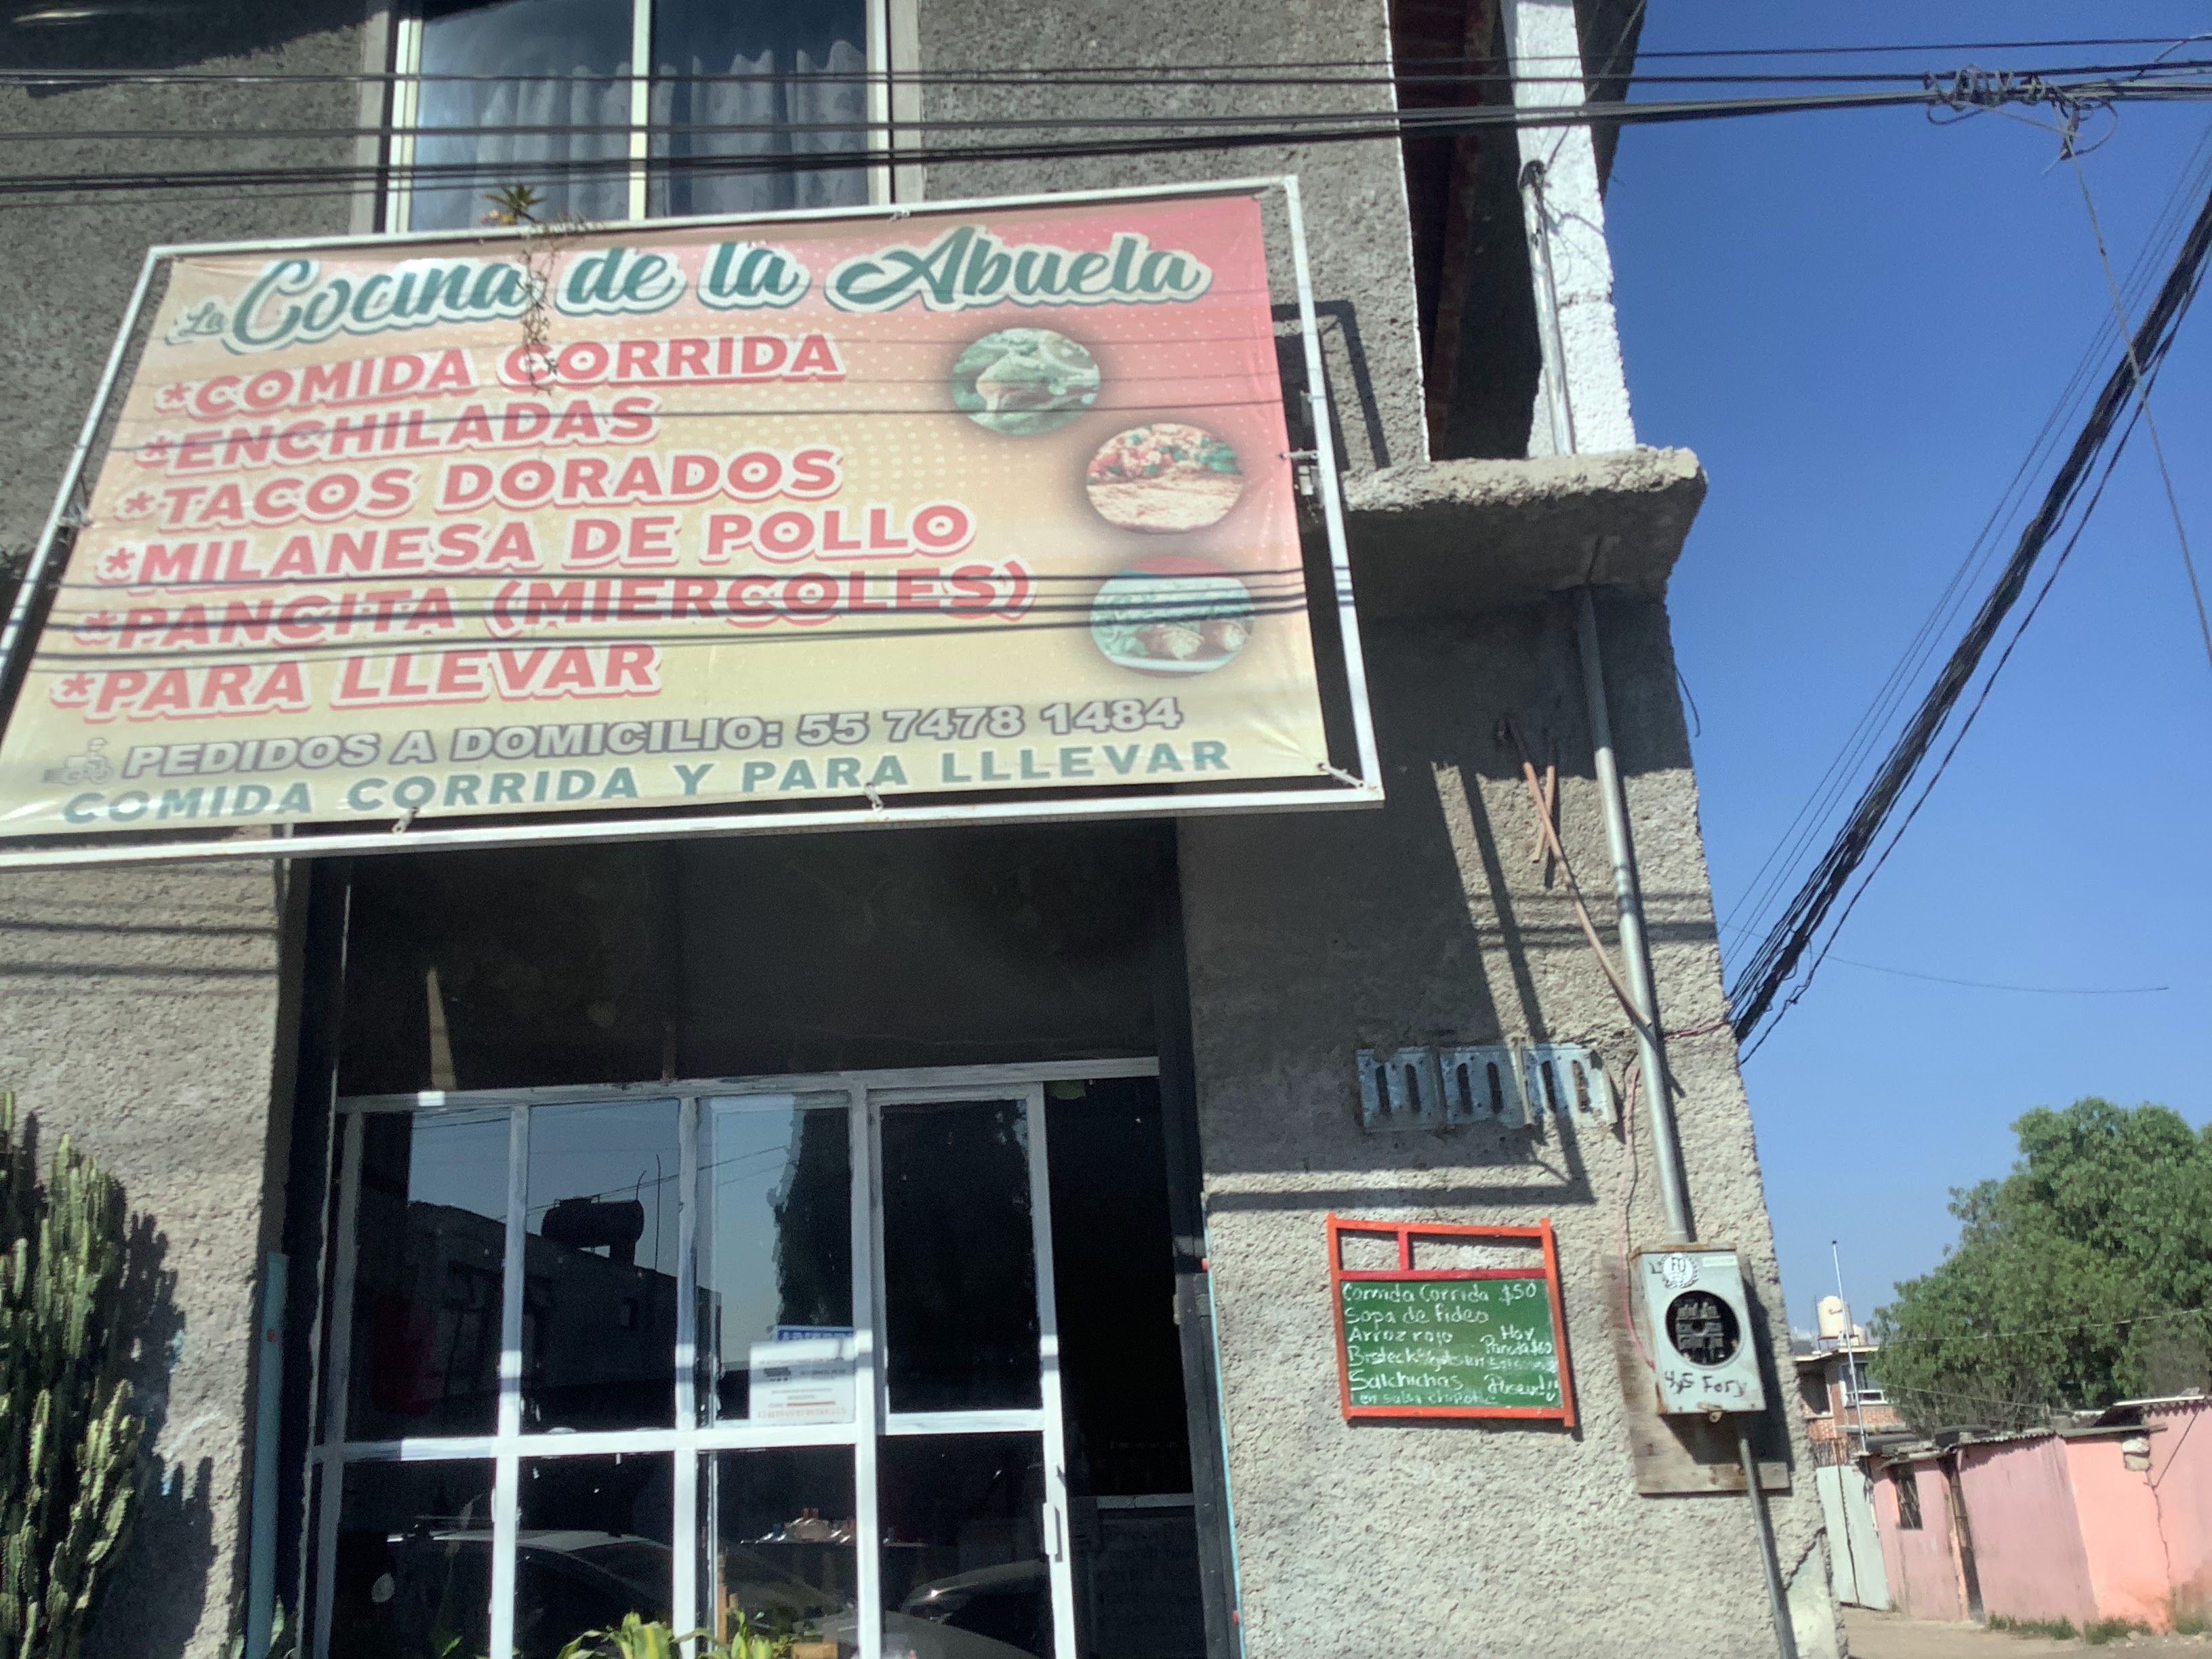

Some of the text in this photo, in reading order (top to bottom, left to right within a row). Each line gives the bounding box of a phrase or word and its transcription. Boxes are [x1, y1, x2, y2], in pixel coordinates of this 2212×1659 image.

[178, 230, 1209, 348] La Cocina de la Abuela
[501, 333, 842, 384] CORRIDA
[441, 449, 841, 507] DORADOS
[569, 516, 678, 562] DE
[705, 504, 970, 557] POLLO
[489, 560, 1030, 636] (MIERCOLES)
[337, 643, 657, 699] LLEVAR
[122, 696, 1183, 779] PEDIDOS A DOMICILIO: 55 7478 1484
[62, 739, 1232, 825] COMIDA CORRIDA Y PARA LLLEVAR
[1341, 1281, 1538, 1306] Comida Corrida $50
[1343, 1307, 1397, 1330] Sopa
[1401, 1305, 1431, 1323] de
[1347, 1326, 1408, 1343] Arroz
